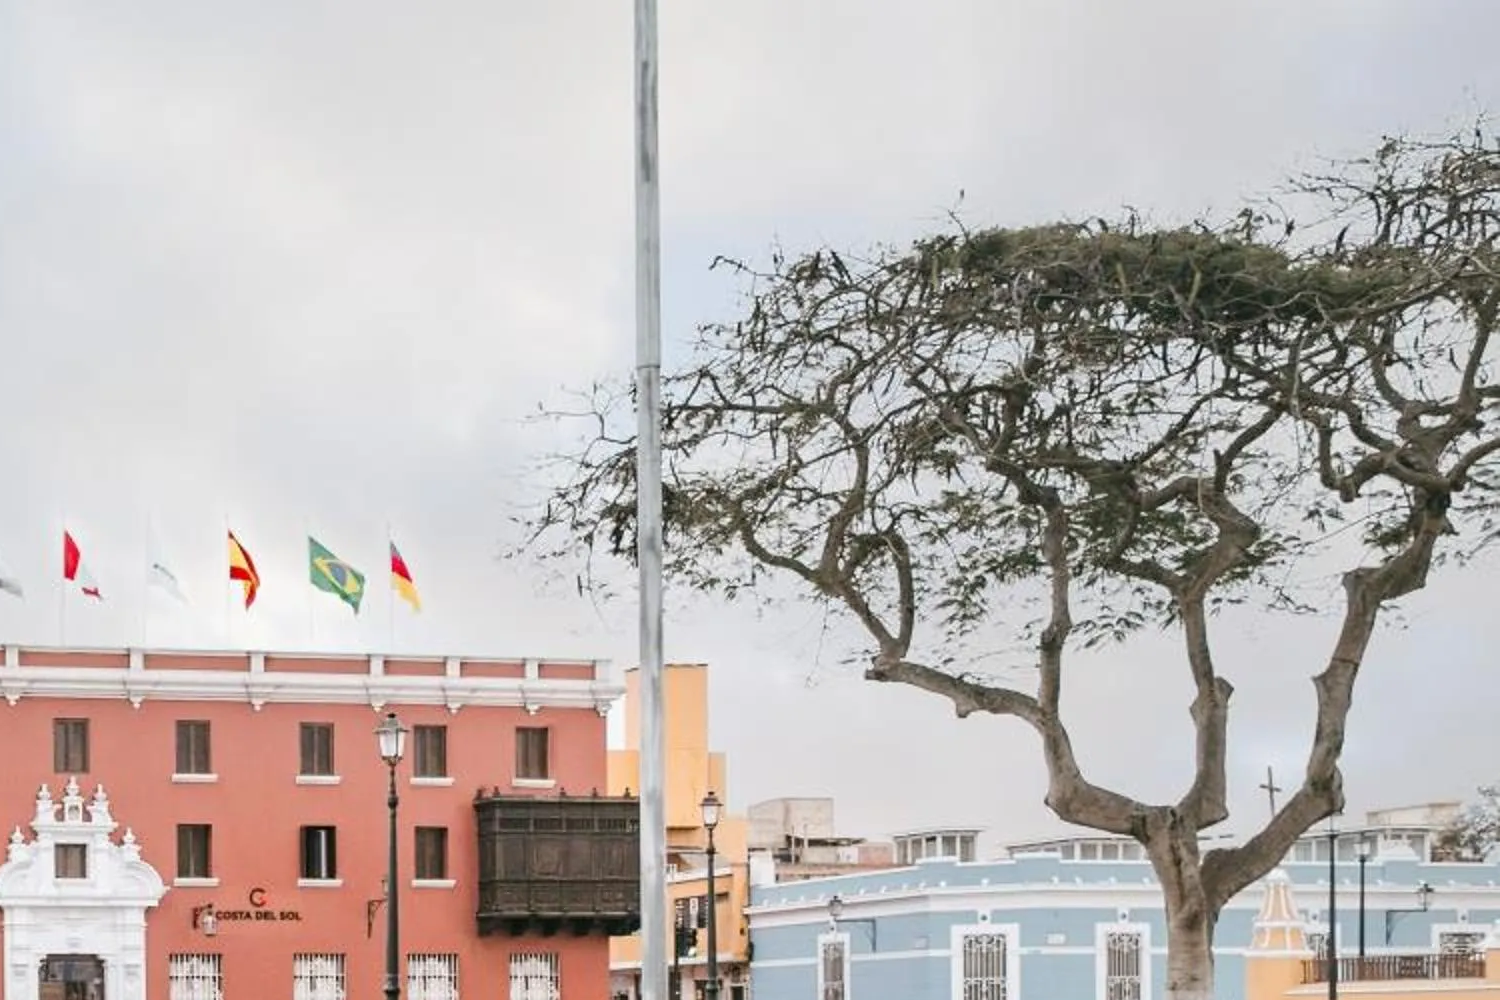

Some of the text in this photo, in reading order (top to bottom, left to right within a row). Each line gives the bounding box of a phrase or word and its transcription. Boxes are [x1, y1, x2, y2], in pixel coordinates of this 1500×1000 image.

[215, 911, 302, 921] COSTA DEL SOL
